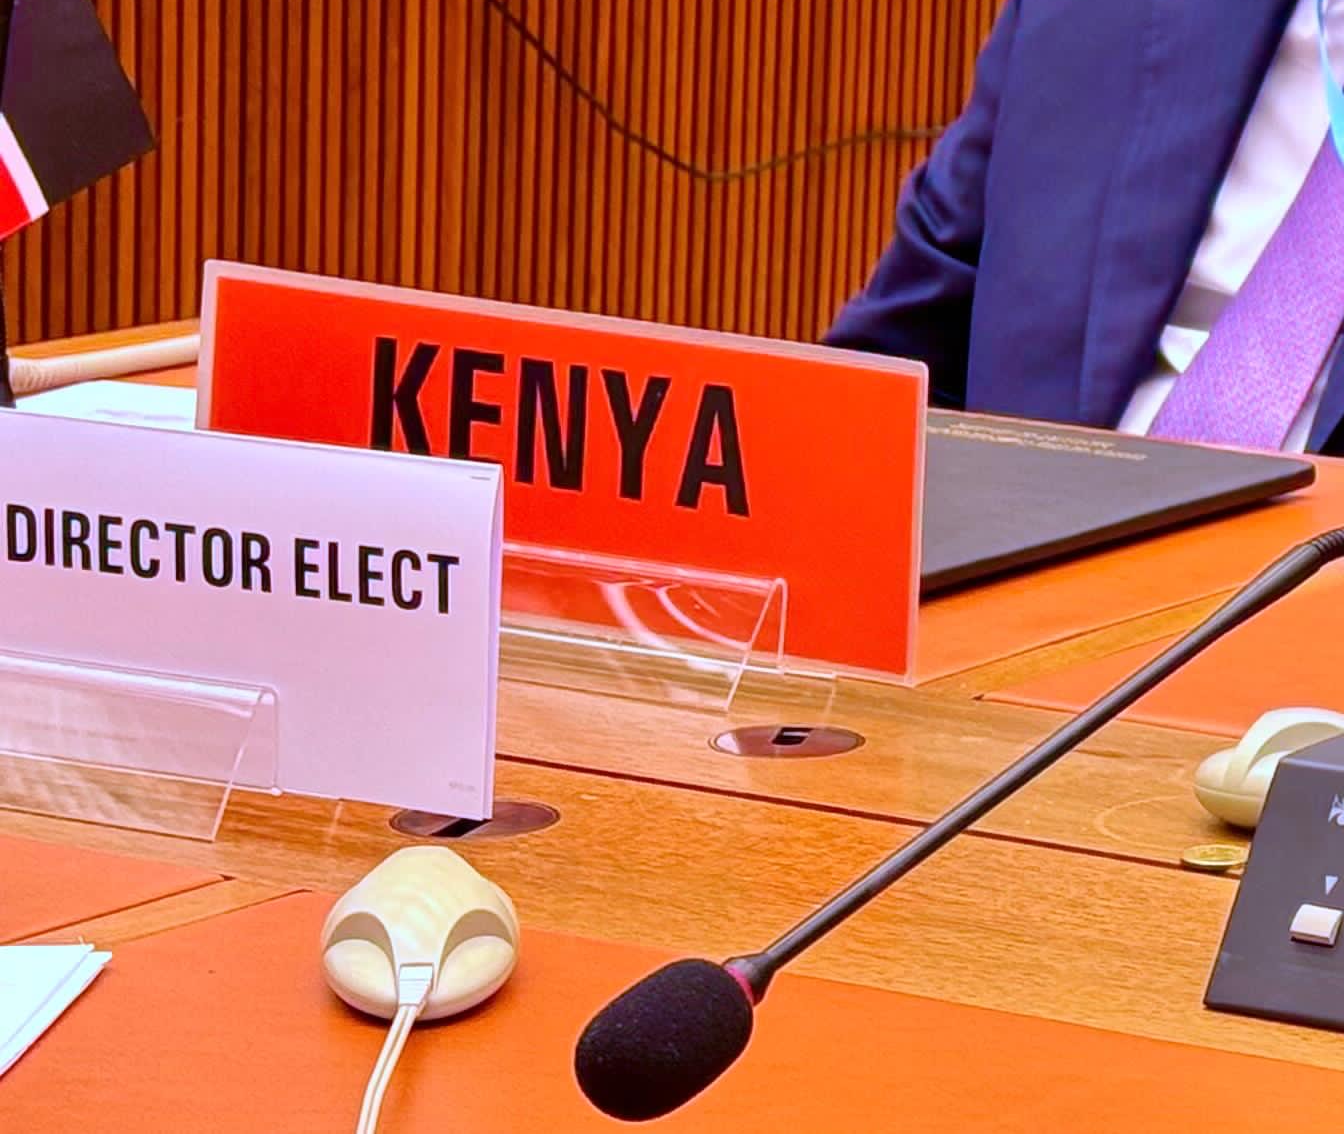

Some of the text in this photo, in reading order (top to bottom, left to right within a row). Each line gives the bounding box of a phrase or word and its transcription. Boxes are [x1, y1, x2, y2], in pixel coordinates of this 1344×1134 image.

[369, 336, 751, 518] KENYA
[5, 503, 461, 615] DIRECTOR ELECT
